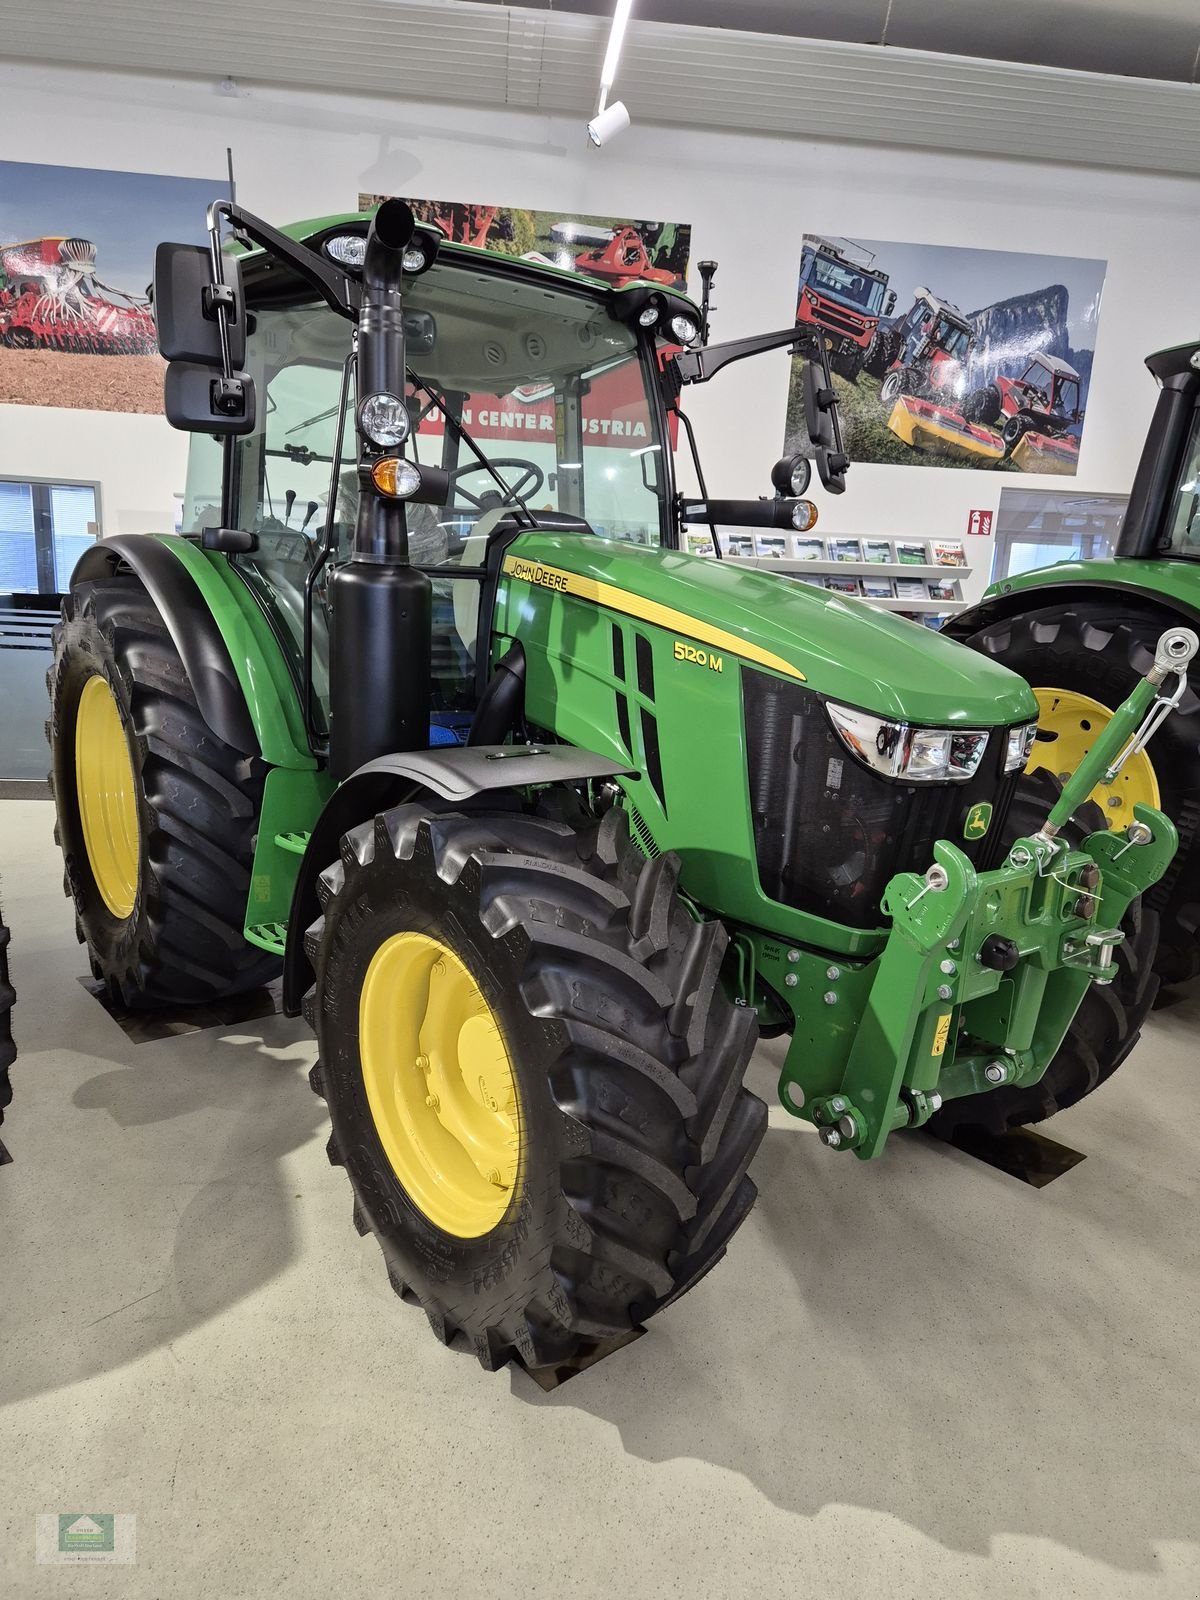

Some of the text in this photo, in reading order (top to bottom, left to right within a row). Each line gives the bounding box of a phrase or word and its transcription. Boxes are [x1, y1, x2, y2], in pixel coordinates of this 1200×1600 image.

[479, 410, 554, 431] CENTER
[581, 418, 647, 438] STRIA
[510, 560, 569, 592] JOHN DEERE
[674, 641, 723, 674] 5120 M
